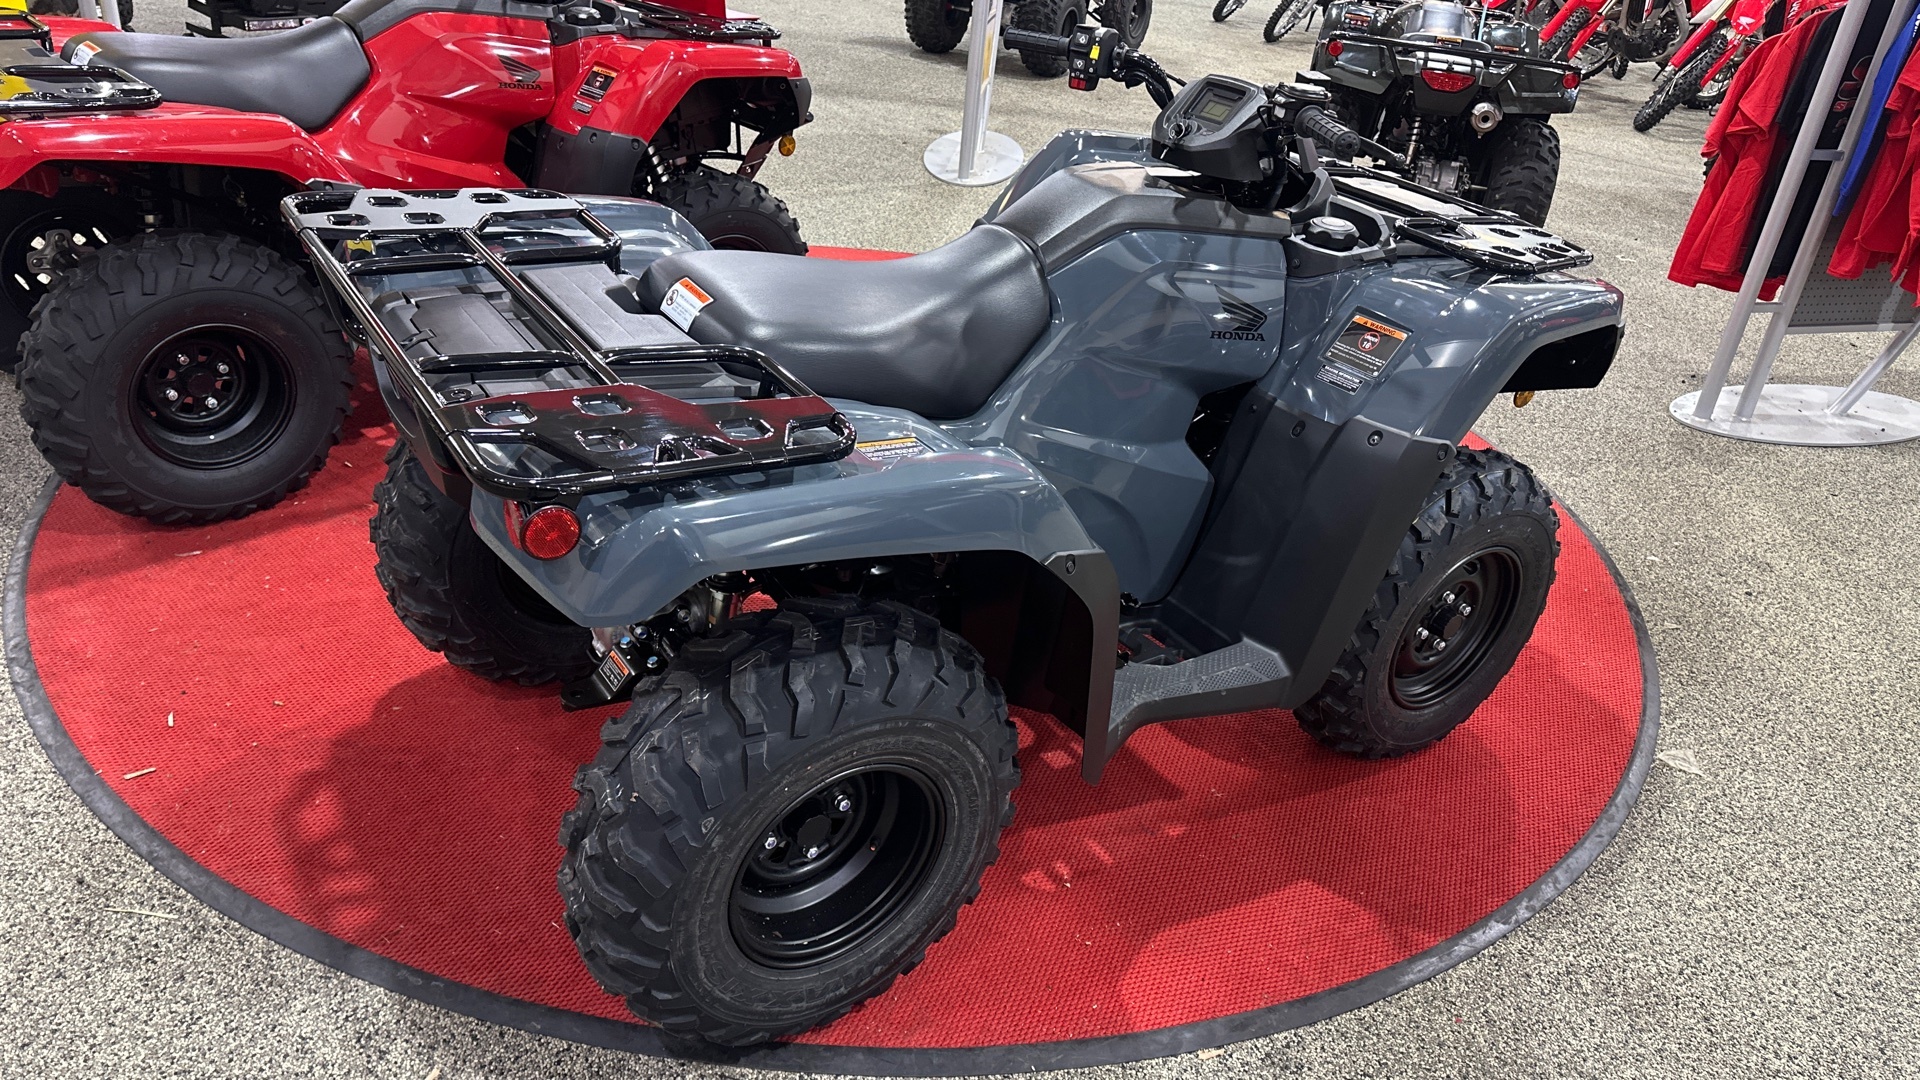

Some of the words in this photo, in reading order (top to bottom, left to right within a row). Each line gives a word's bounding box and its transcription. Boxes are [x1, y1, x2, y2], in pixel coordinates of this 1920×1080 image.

[498, 82, 543, 90] HONDA
[1369, 321, 1397, 336] WARNING
[1210, 330, 1266, 342] HONDA
[1362, 341, 1371, 349] 16
